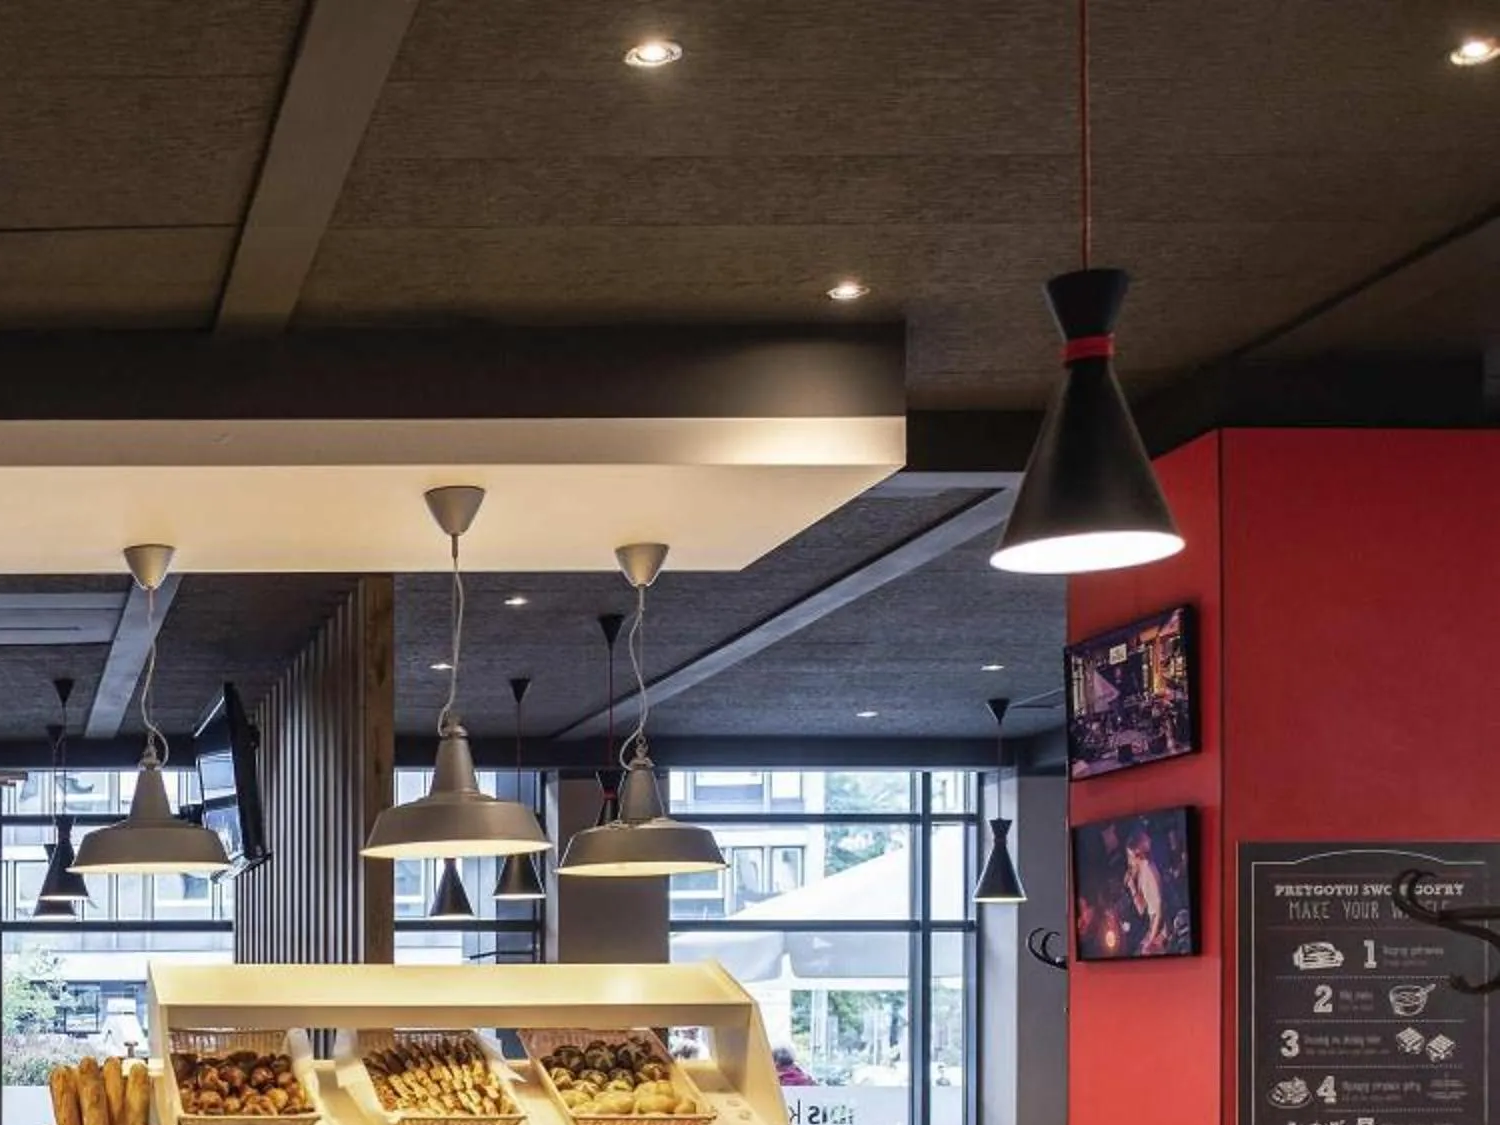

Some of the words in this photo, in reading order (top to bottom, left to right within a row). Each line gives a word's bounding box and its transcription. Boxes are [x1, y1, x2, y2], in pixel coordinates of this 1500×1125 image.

[1289, 901, 1330, 920] MAKE
[1342, 900, 1379, 920] YOUR
[1364, 940, 1377, 969] 1
[1313, 985, 1333, 1013] 2
[1281, 1029, 1299, 1057] 3
[1316, 1076, 1337, 1104] 4
